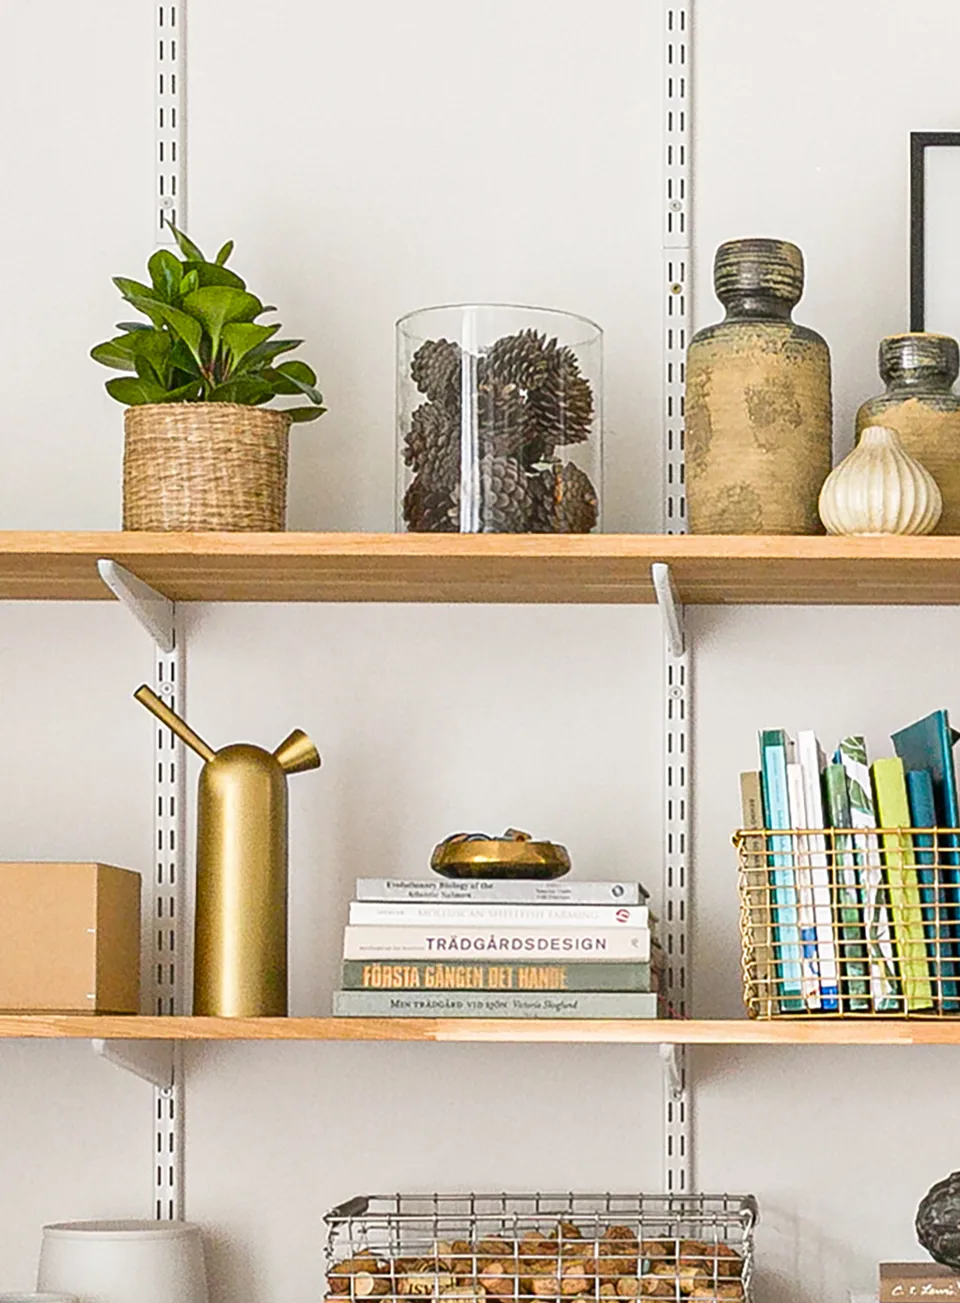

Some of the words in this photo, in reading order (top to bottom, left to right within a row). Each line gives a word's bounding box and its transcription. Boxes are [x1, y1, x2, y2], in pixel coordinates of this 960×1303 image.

[425, 934, 607, 951] TRÄDGÅRDSDESIGN
[362, 962, 420, 988] FÖRSTA
[424, 963, 483, 989] GÅNGEN
[487, 965, 513, 988] DET
[466, 1000, 483, 1008] VID
